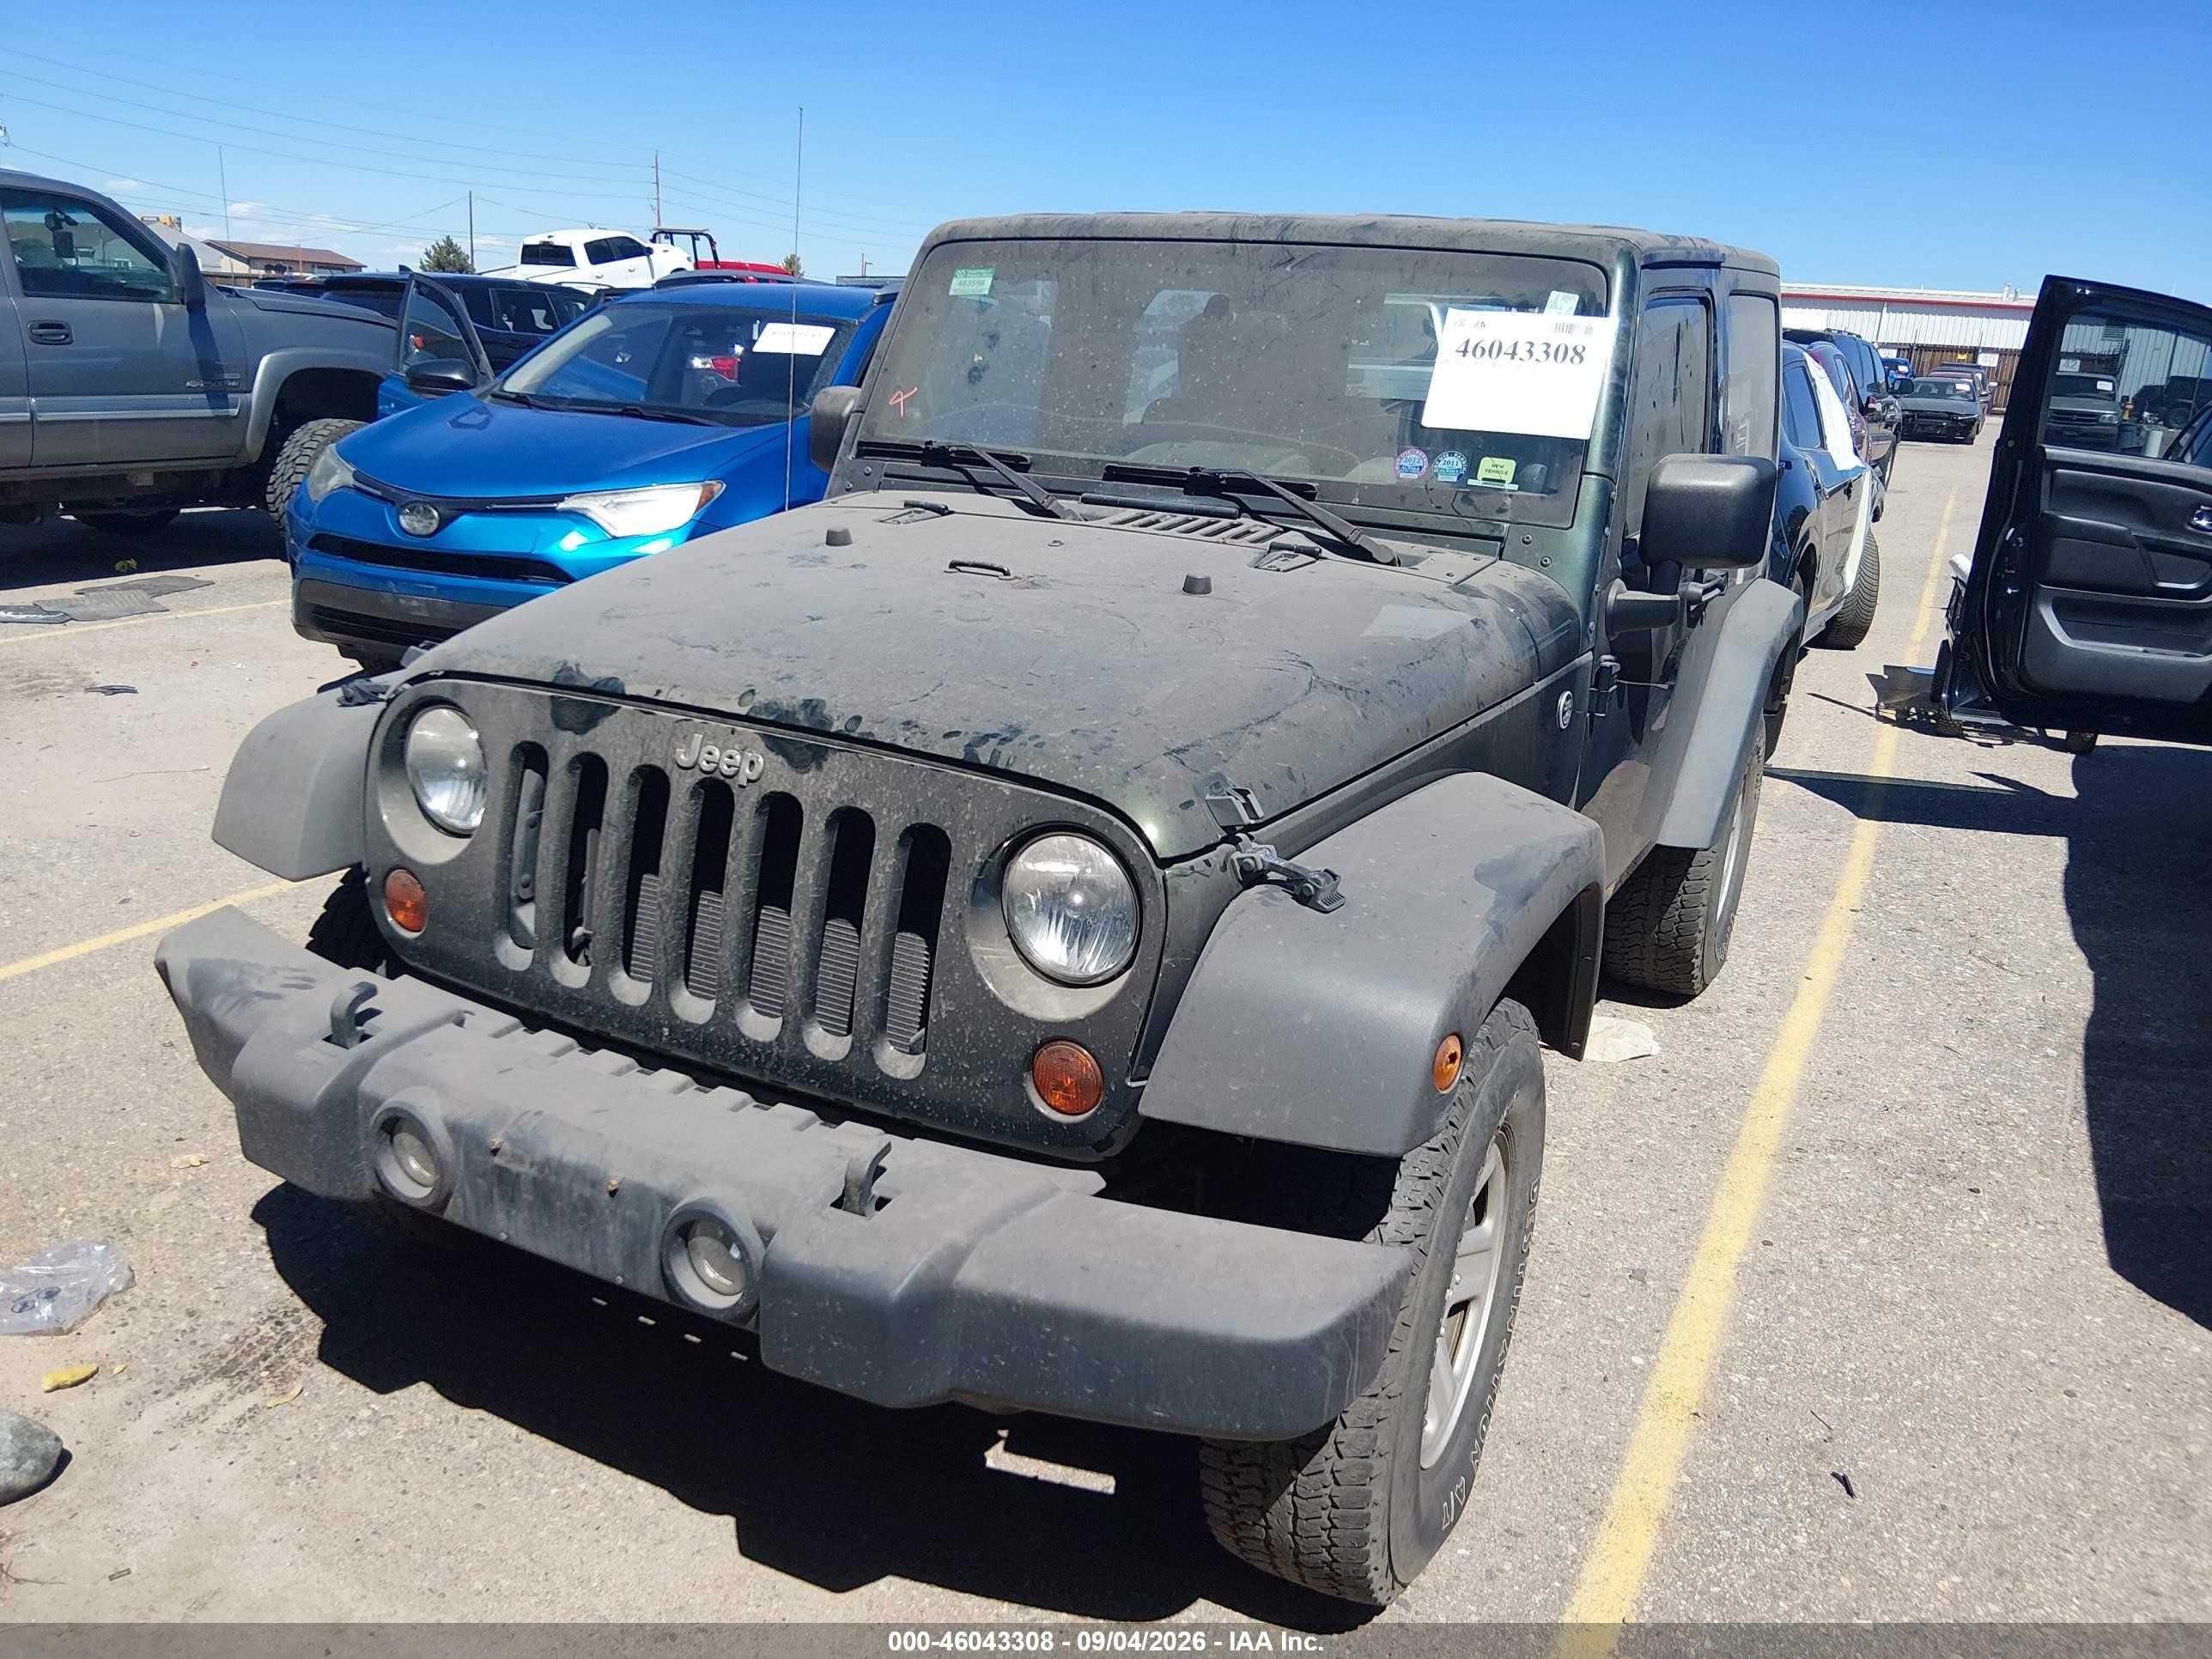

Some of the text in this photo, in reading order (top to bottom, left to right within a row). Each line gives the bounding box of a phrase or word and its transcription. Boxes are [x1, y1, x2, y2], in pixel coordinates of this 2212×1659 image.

[1455, 337, 1587, 366] 46043308
[2062, 361, 2077, 370] 42
[676, 733, 764, 787] Jeep
